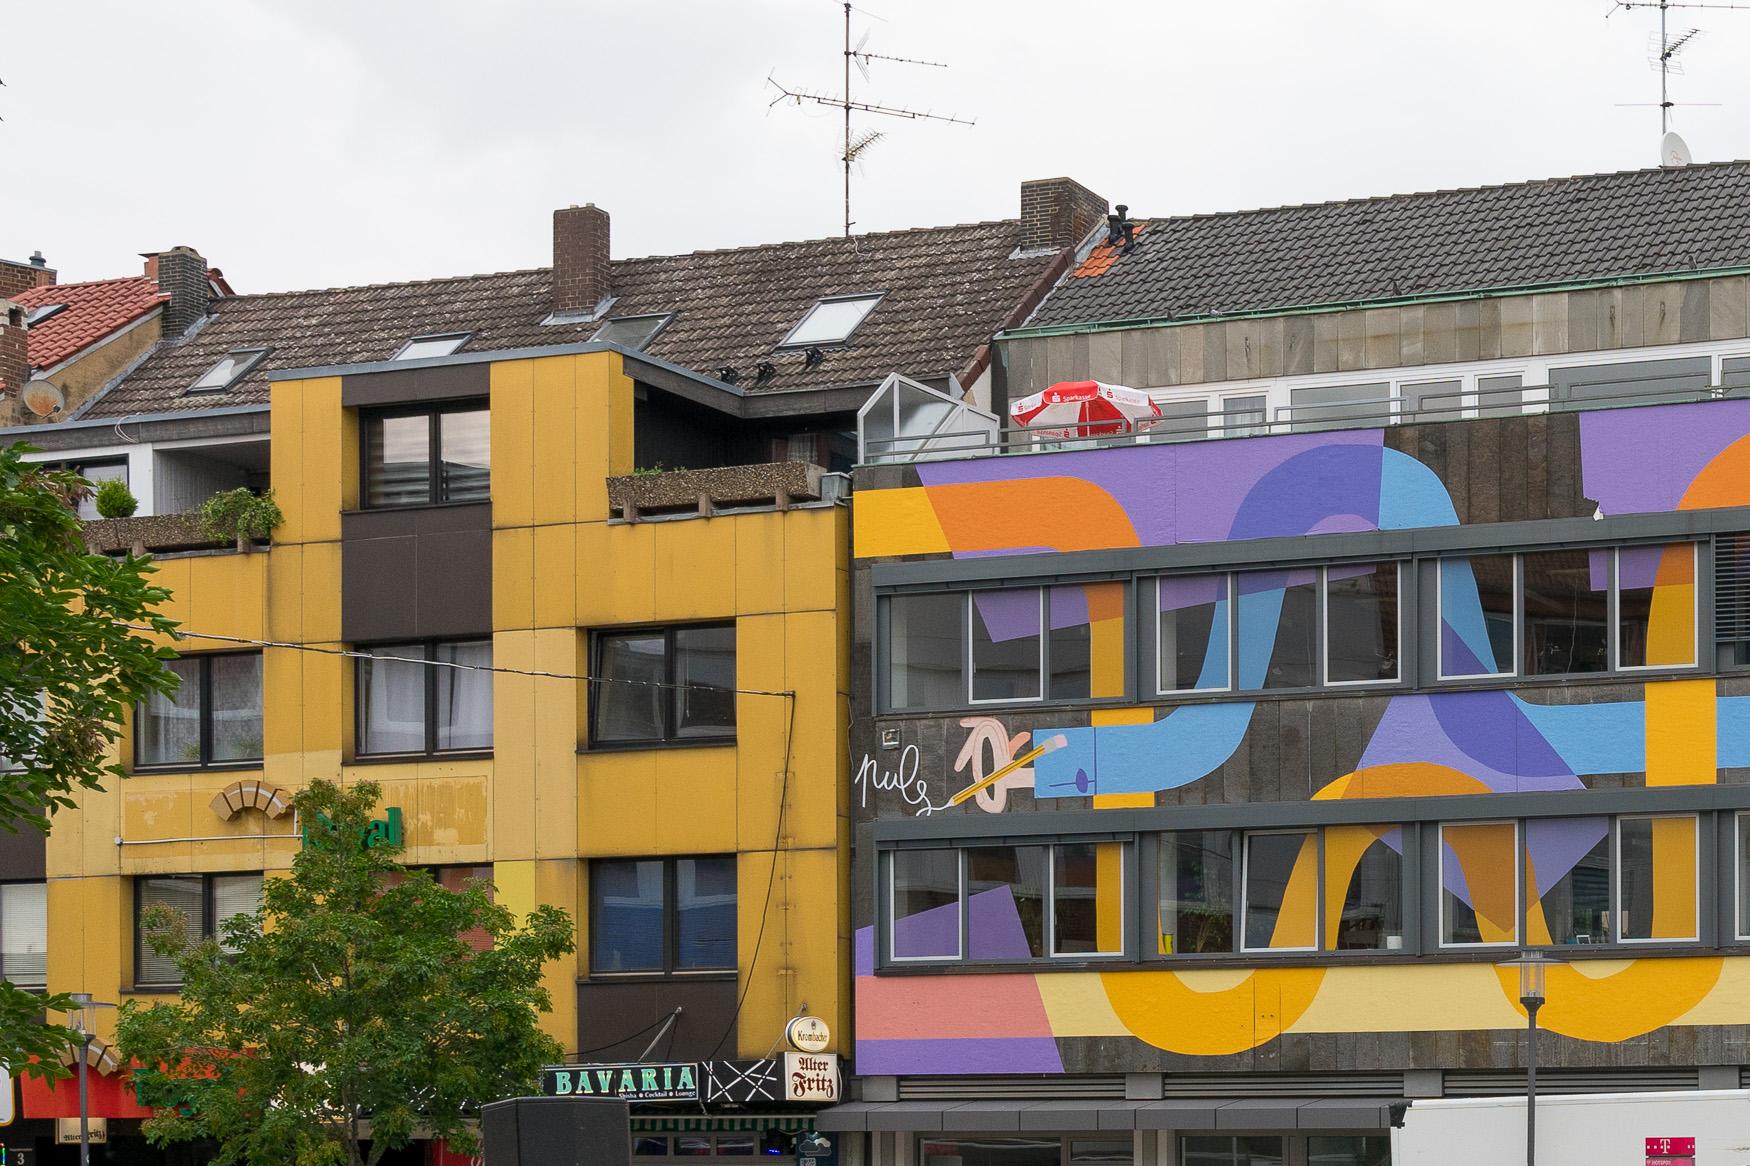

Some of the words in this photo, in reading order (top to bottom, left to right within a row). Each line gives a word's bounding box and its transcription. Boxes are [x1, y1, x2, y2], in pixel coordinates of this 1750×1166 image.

[1062, 394, 1091, 402] Sparkasse
[797, 1030, 828, 1042] Krombacher
[798, 1056, 829, 1072] Alter
[555, 1066, 696, 1095] BAVARIA
[791, 1071, 835, 1098] Fritz
[1660, 1138, 1671, 1154] T
[17, 1152, 25, 1165] 3
